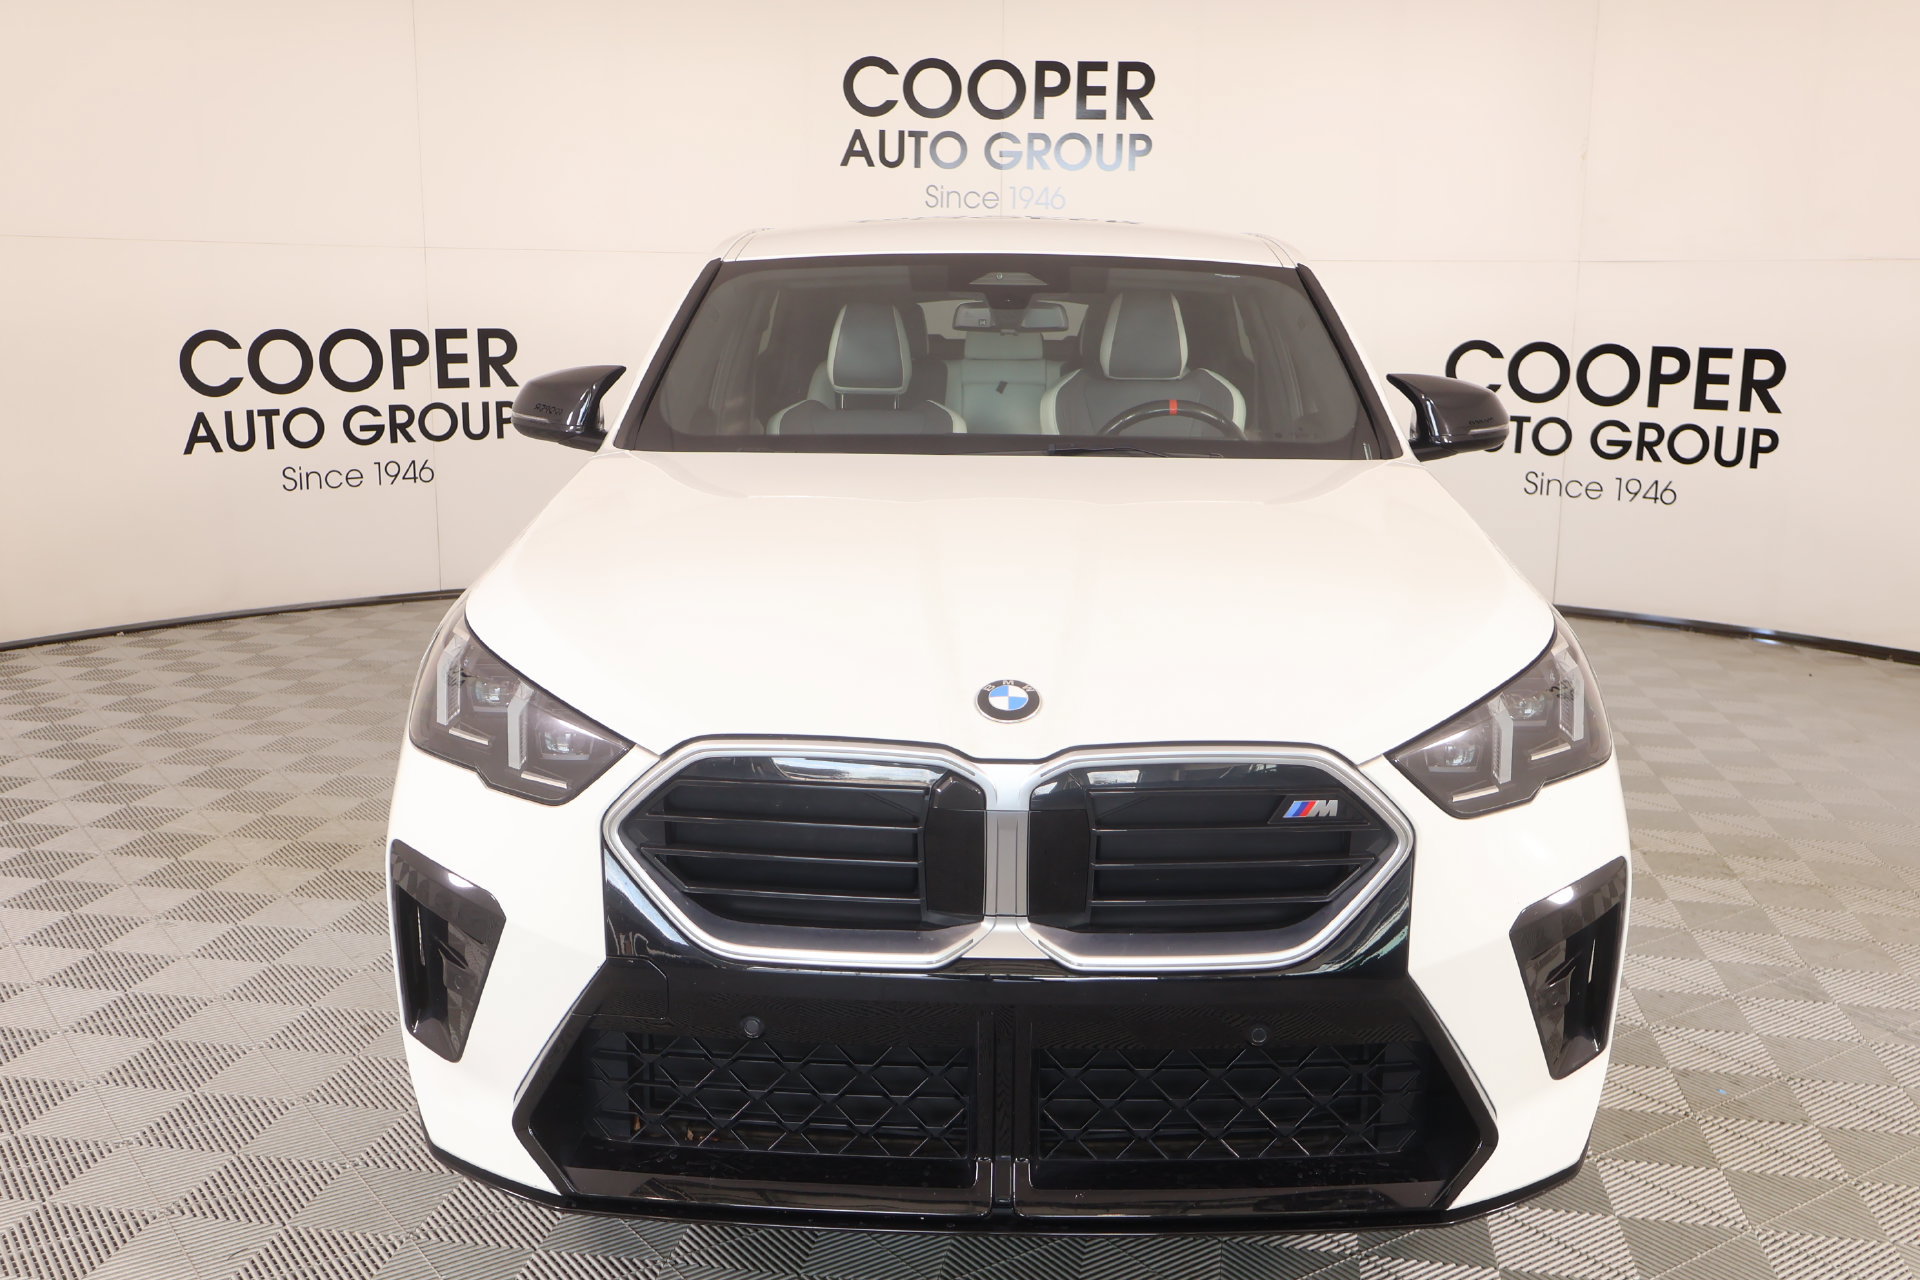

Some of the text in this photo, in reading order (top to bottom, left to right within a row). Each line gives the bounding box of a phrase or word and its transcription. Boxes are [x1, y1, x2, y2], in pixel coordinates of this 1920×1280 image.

[842, 55, 1156, 121] COOPER
[839, 128, 1153, 172] AUTO GROUP
[924, 184, 1067, 211] Since 1946
[179, 327, 519, 398] COOPER
[1445, 339, 1787, 414] COOPER
[183, 401, 514, 456] AUTO GROUP
[1484, 415, 1780, 470] TO GROUP
[281, 459, 436, 492] Since 1946
[1523, 470, 1678, 506] Since 1946
[983, 679, 1036, 692] BMW
